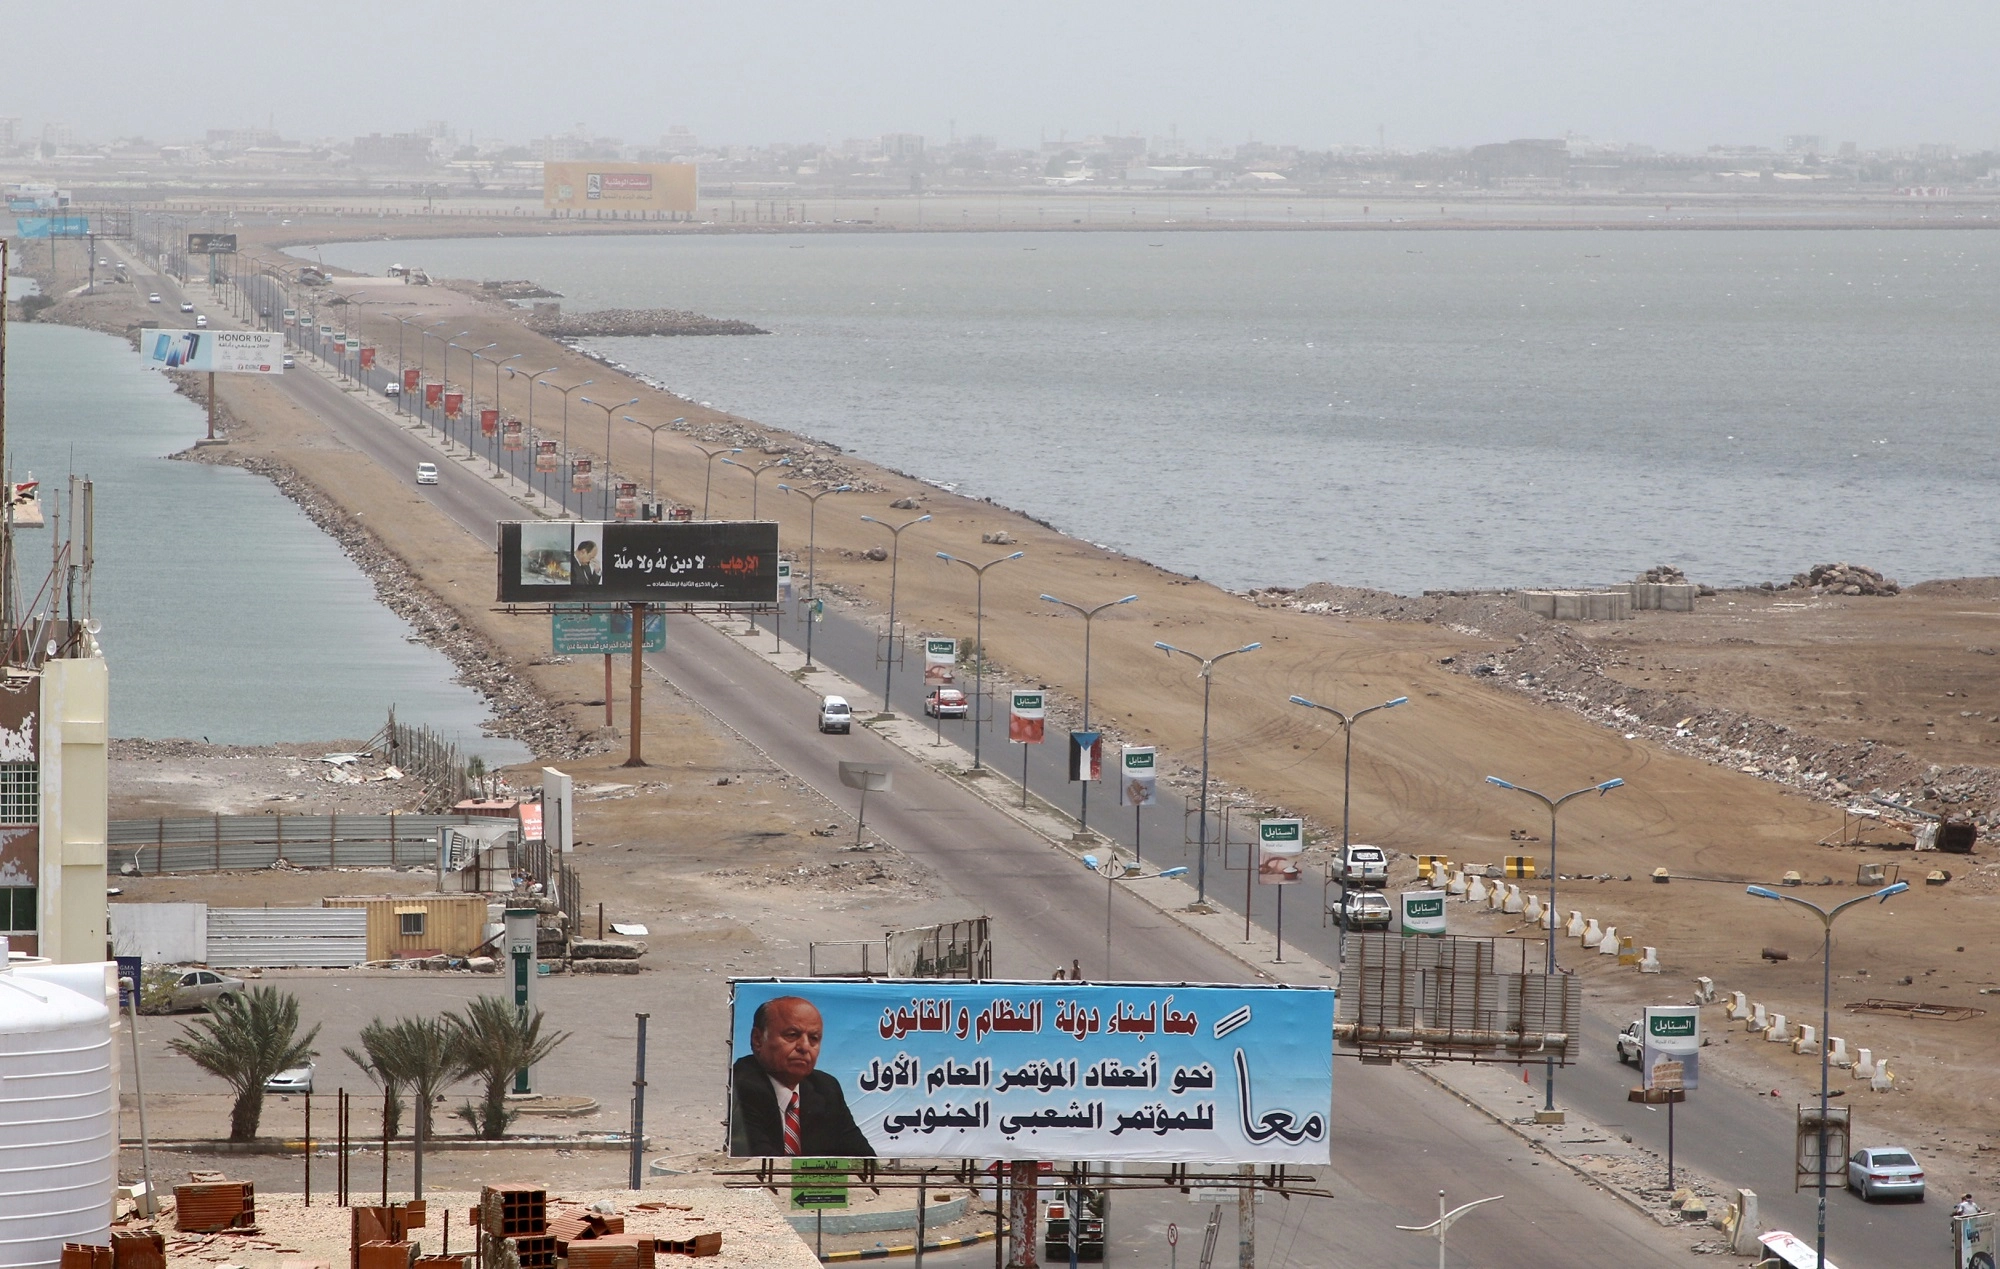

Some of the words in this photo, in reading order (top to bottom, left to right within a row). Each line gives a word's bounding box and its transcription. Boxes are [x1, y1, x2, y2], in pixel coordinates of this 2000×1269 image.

[637, 555, 653, 573] ولا
[669, 555, 693, 574] دين
[695, 555, 706, 569] لا
[1017, 697, 1040, 707] السنابل
[1265, 826, 1296, 839] السنابل
[1411, 902, 1440, 915] السنابل
[879, 998, 951, 1040] القانون
[954, 1007, 970, 1040] و
[976, 998, 1042, 1044] النظام
[1054, 999, 1100, 1041] دولة
[1106, 999, 1157, 1042] لبناء
[1655, 1020, 1691, 1033] السنابل
[859, 1053, 918, 1092] الأول
[927, 1059, 990, 1095] العام
[995, 1060, 1077, 1093] المؤتمر
[1085, 1053, 1158, 1089] أنعقاد
[1171, 1064, 1213, 1095] نحو
[883, 1100, 989, 1140] الجنوبي
[999, 1101, 1102, 1141] الشعبي
[1109, 1102, 1214, 1136] للمؤتمر
